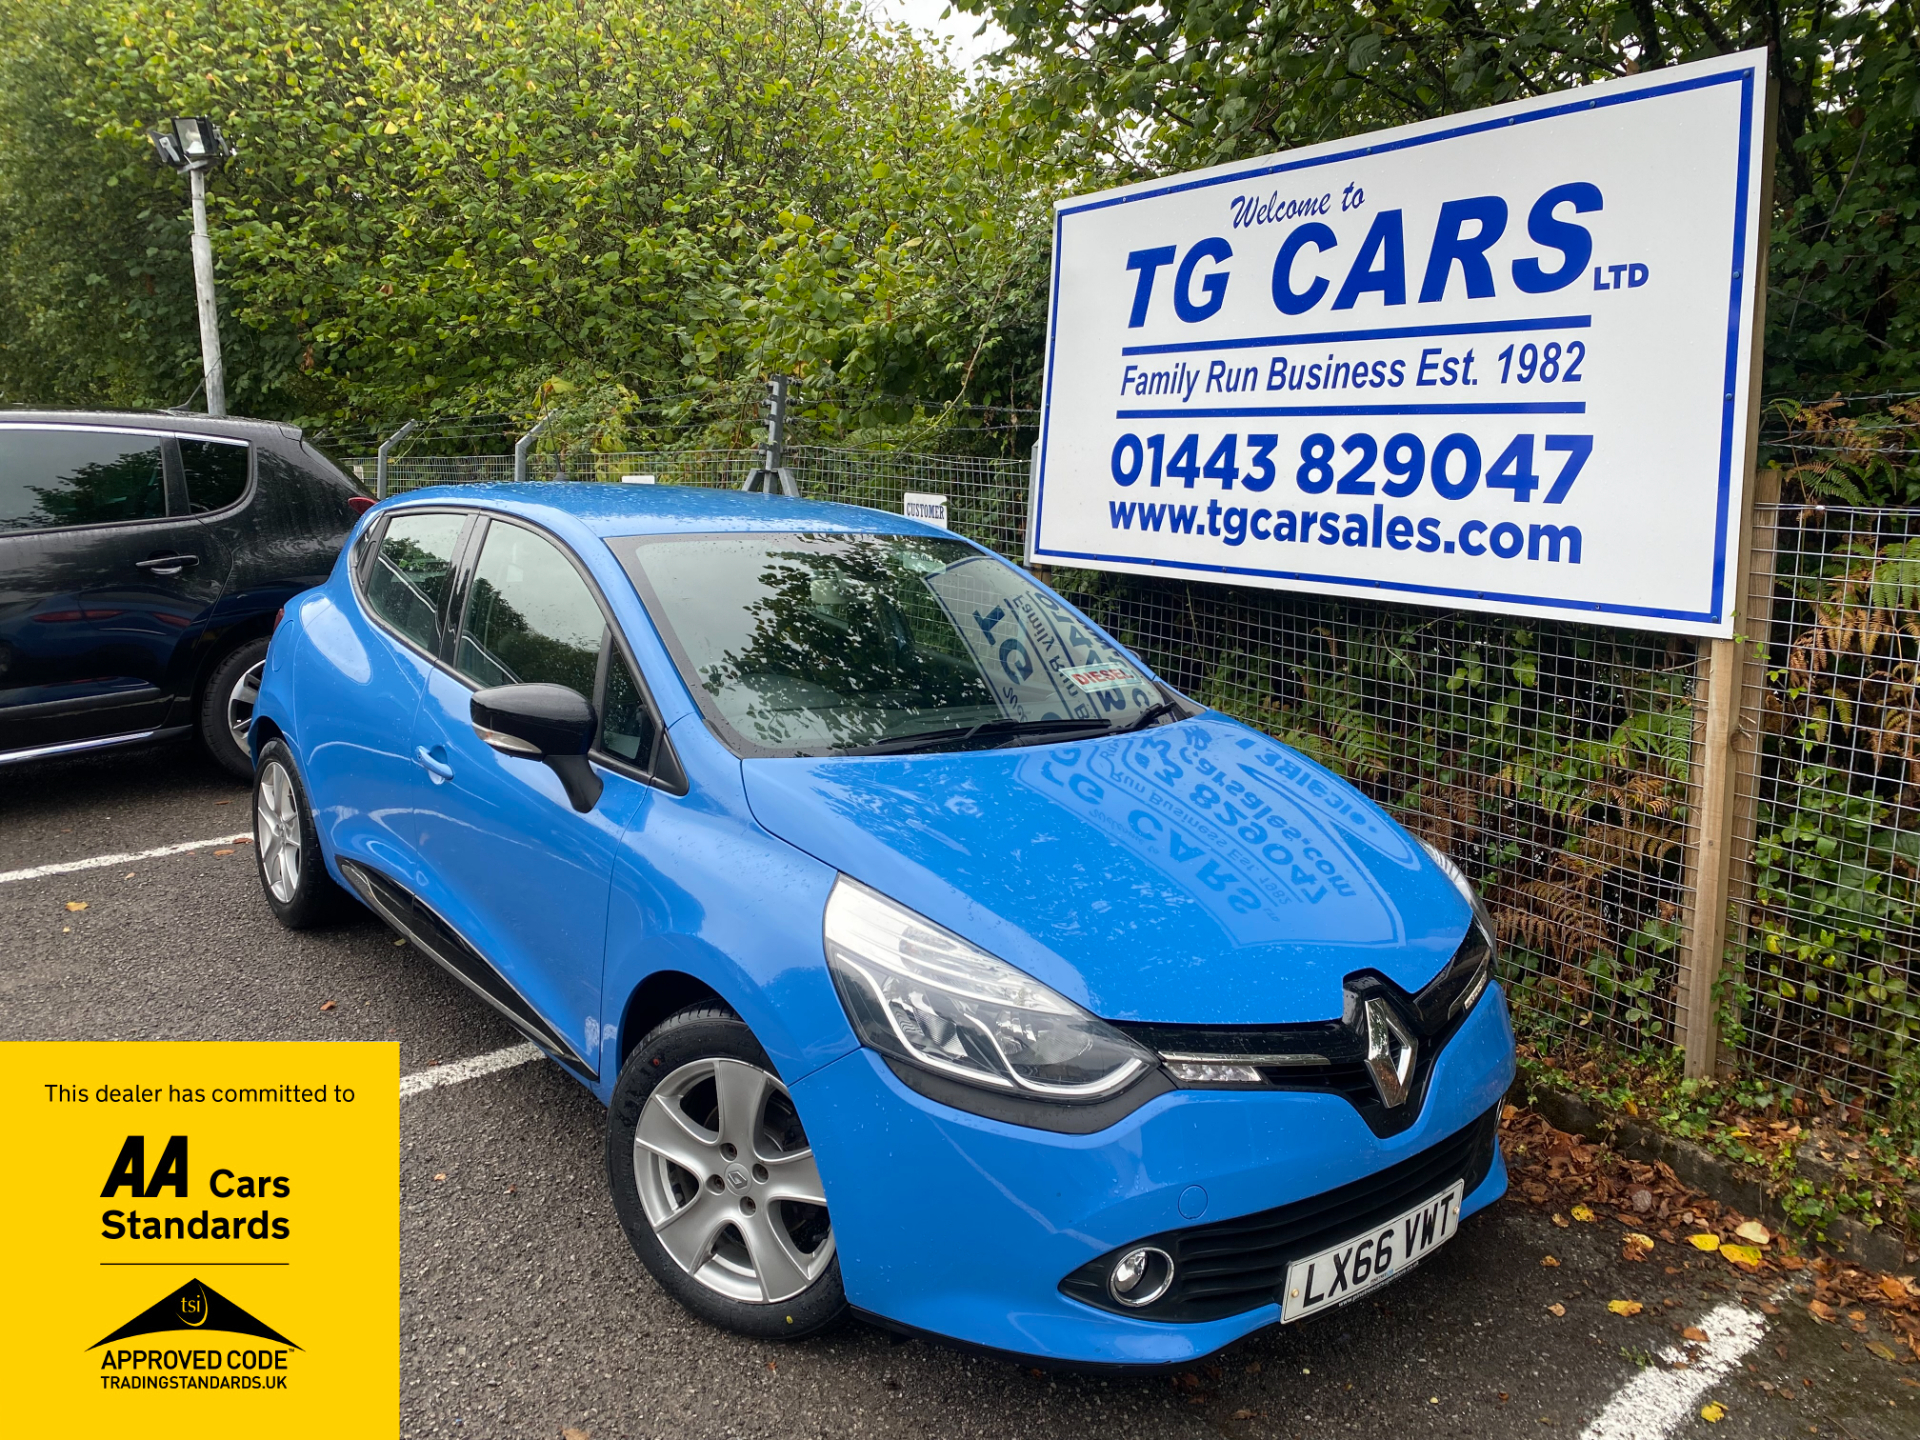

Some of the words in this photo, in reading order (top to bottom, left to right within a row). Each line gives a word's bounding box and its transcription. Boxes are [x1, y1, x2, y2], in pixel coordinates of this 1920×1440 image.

[1230, 189, 1332, 229] Welcome
[1341, 181, 1366, 212] to
[1126, 236, 1233, 328] TG
[1271, 181, 1604, 316] CARS
[1593, 262, 1649, 291] LTD
[1121, 361, 1200, 403] Family
[1204, 361, 1258, 393] Run
[1266, 352, 1406, 391] Business
[1416, 347, 1479, 387] Est.
[1498, 340, 1586, 384] 1982
[1111, 433, 1279, 492] 01443
[1296, 433, 1594, 504] 829047
[906, 502, 945, 520] CUSTOMER
[1109, 499, 1582, 564] www.tgcarsales.com
[1071, 667, 1134, 686] DIESEL
[1303, 1228, 1395, 1309] LX66
[1405, 1192, 1455, 1260] VWT
